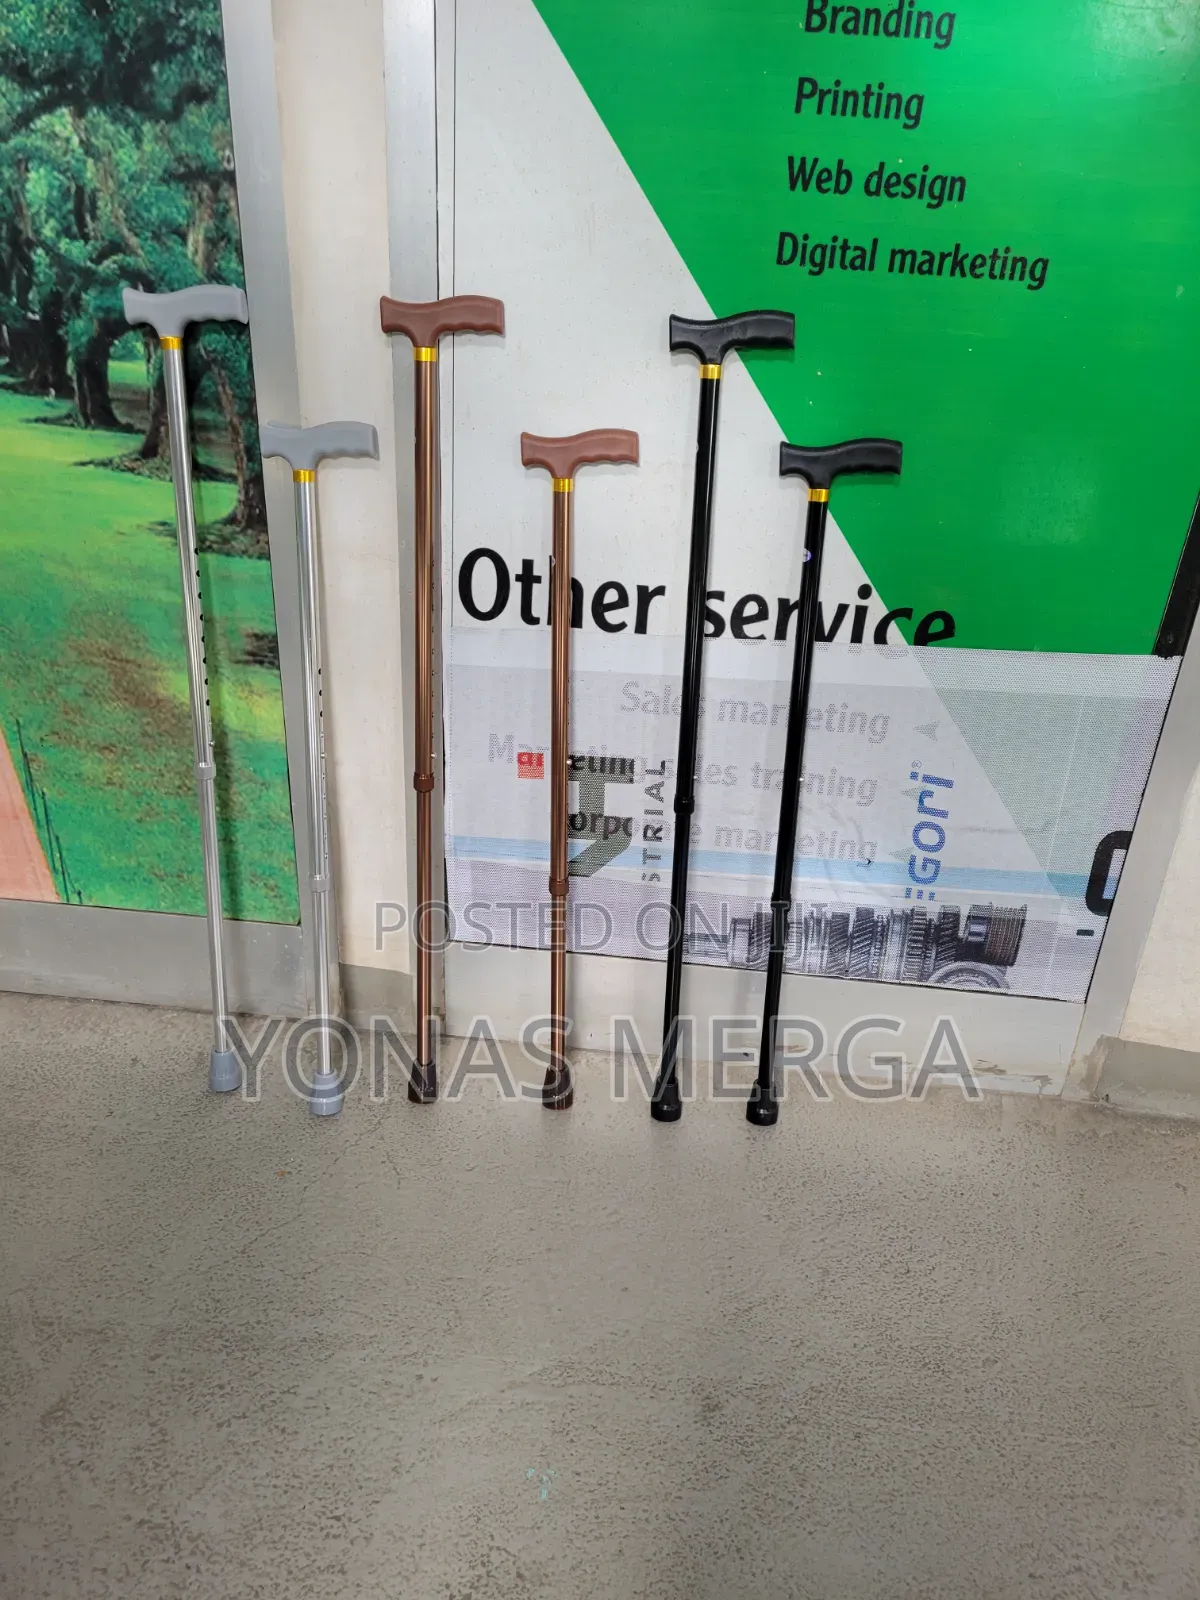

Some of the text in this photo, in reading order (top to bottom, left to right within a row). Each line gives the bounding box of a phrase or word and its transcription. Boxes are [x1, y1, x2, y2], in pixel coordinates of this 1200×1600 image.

[804, 0, 956, 49] Branding
[794, 76, 925, 130] Printing
[787, 155, 967, 209] Web design
[775, 231, 1049, 291] Digital marketing
[717, 699, 891, 744] mareting
[488, 733, 648, 784] Mareting
[714, 825, 878, 866] mareting
